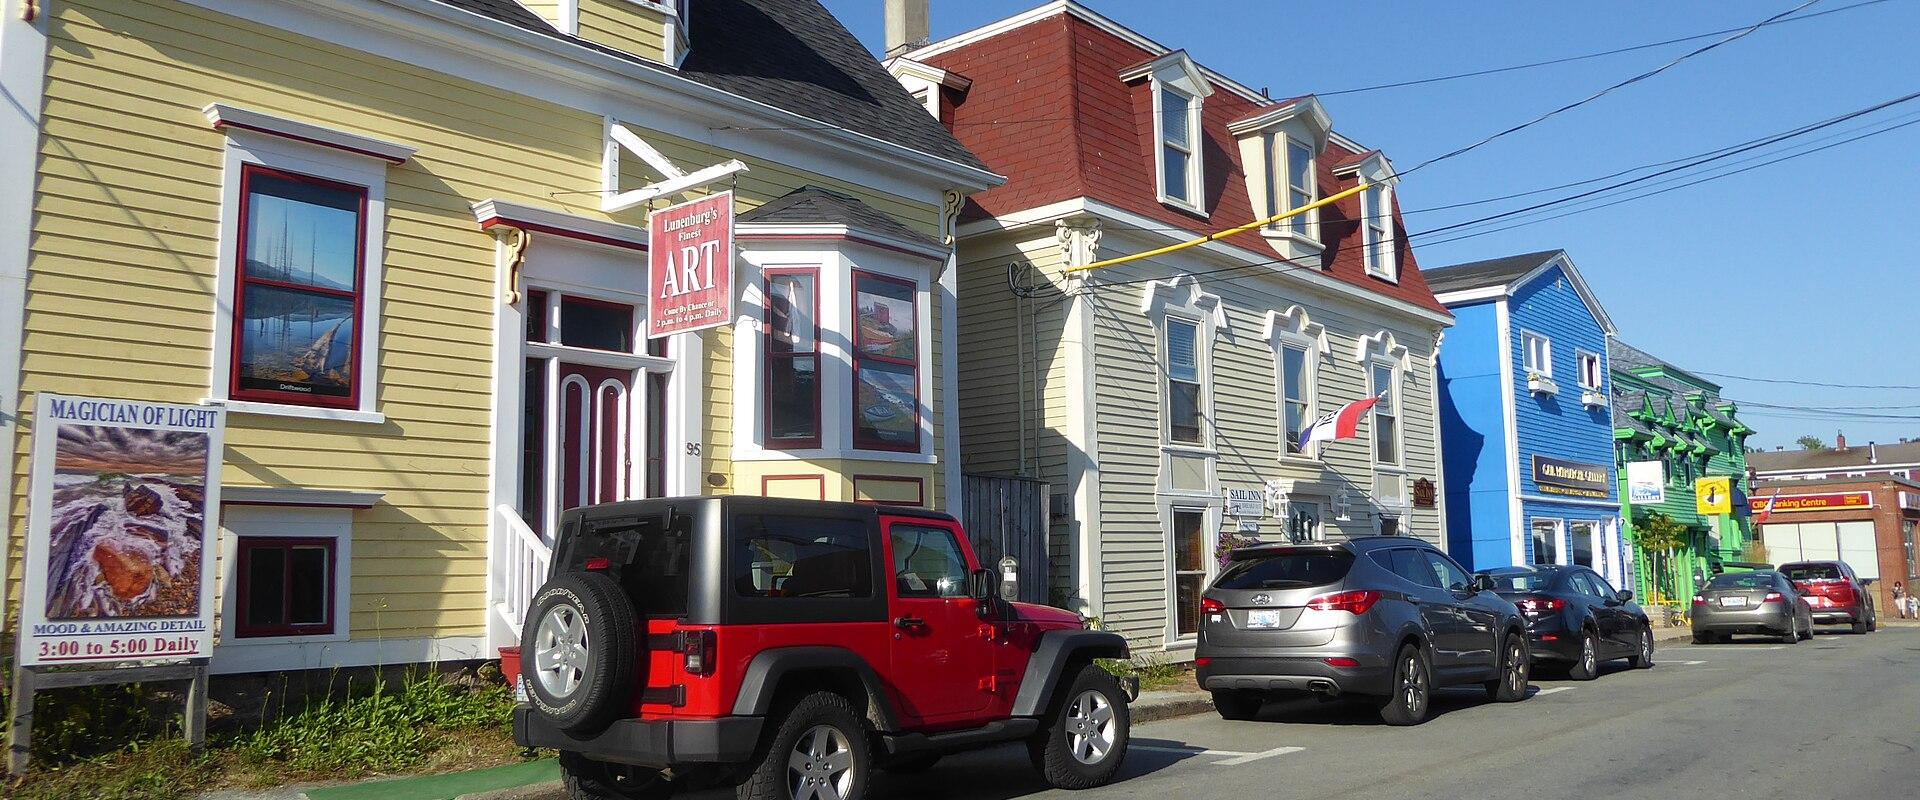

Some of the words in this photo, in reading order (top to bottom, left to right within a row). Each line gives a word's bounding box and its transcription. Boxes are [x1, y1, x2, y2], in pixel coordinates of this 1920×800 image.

[664, 207, 718, 233] Lunenburg's
[678, 228, 702, 242] Finest
[660, 240, 720, 299] ART
[664, 308, 679, 316] Come
[679, 305, 687, 314] By
[688, 302, 707, 311] Chance
[656, 319, 661, 327] 2
[661, 318, 675, 328] p.m.
[689, 312, 704, 322] p.m.
[705, 308, 722, 318] Daily
[280, 383, 312, 392] Driftwood
[50, 399, 139, 423] MAGICIAN
[143, 406, 165, 425] OF
[168, 408, 218, 428] LIGHT
[687, 442, 701, 456] 95
[1230, 490, 1247, 499] SAIL
[1248, 490, 1261, 500] INN
[1774, 499, 1799, 508] anking
[1801, 499, 1827, 507] Centre
[537, 587, 590, 624] GOODYEAR
[33, 623, 77, 635] MOOD
[81, 622, 91, 633] &
[94, 621, 157, 633] AMAZING
[160, 619, 206, 630] DETAIL
[39, 641, 79, 656] 3:00
[86, 641, 103, 655] to
[110, 638, 148, 653] 5:00
[153, 636, 199, 653] Daily
